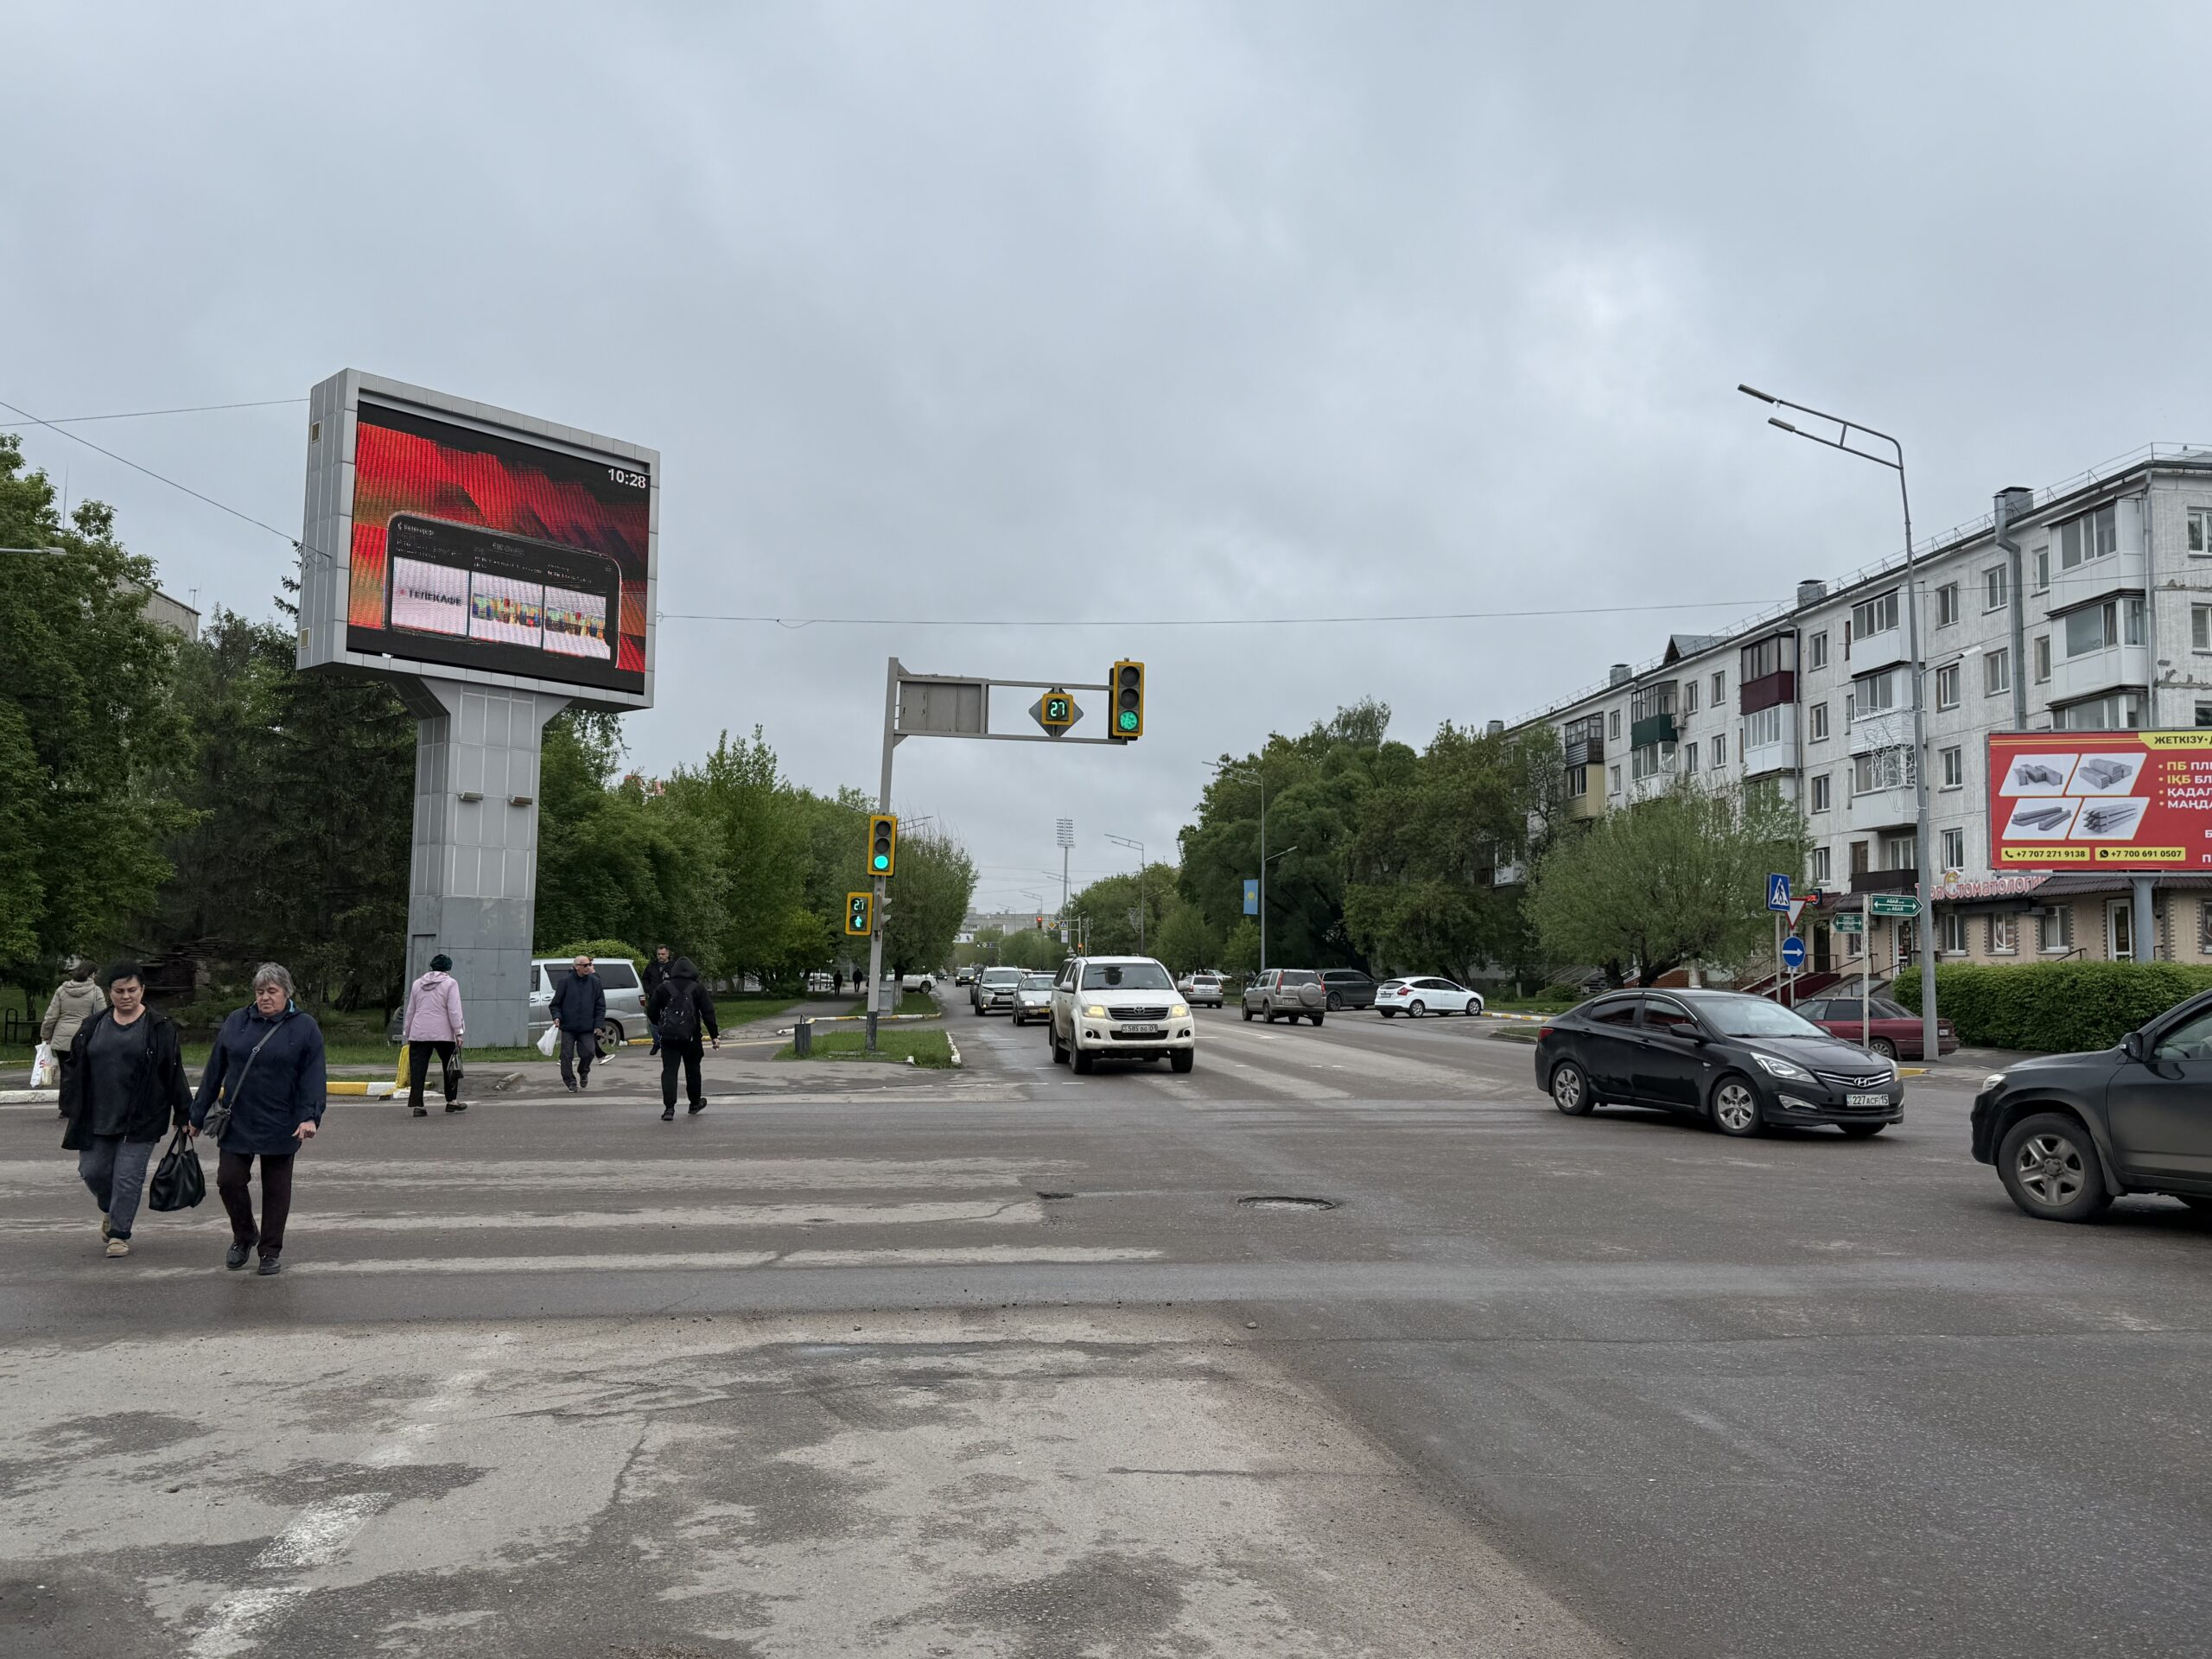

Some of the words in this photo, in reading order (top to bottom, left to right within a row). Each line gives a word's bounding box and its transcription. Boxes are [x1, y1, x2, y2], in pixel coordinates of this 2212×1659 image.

[608, 468, 646, 489] 10:28
[1050, 702, 1065, 717] 27
[2166, 761, 2187, 771] ПБ
[2190, 761, 2212, 771] ПЛ
[2167, 774, 2191, 785] ІҚБ
[1853, 1096, 1866, 1105] 227
[1880, 1095, 1888, 1104] 15
